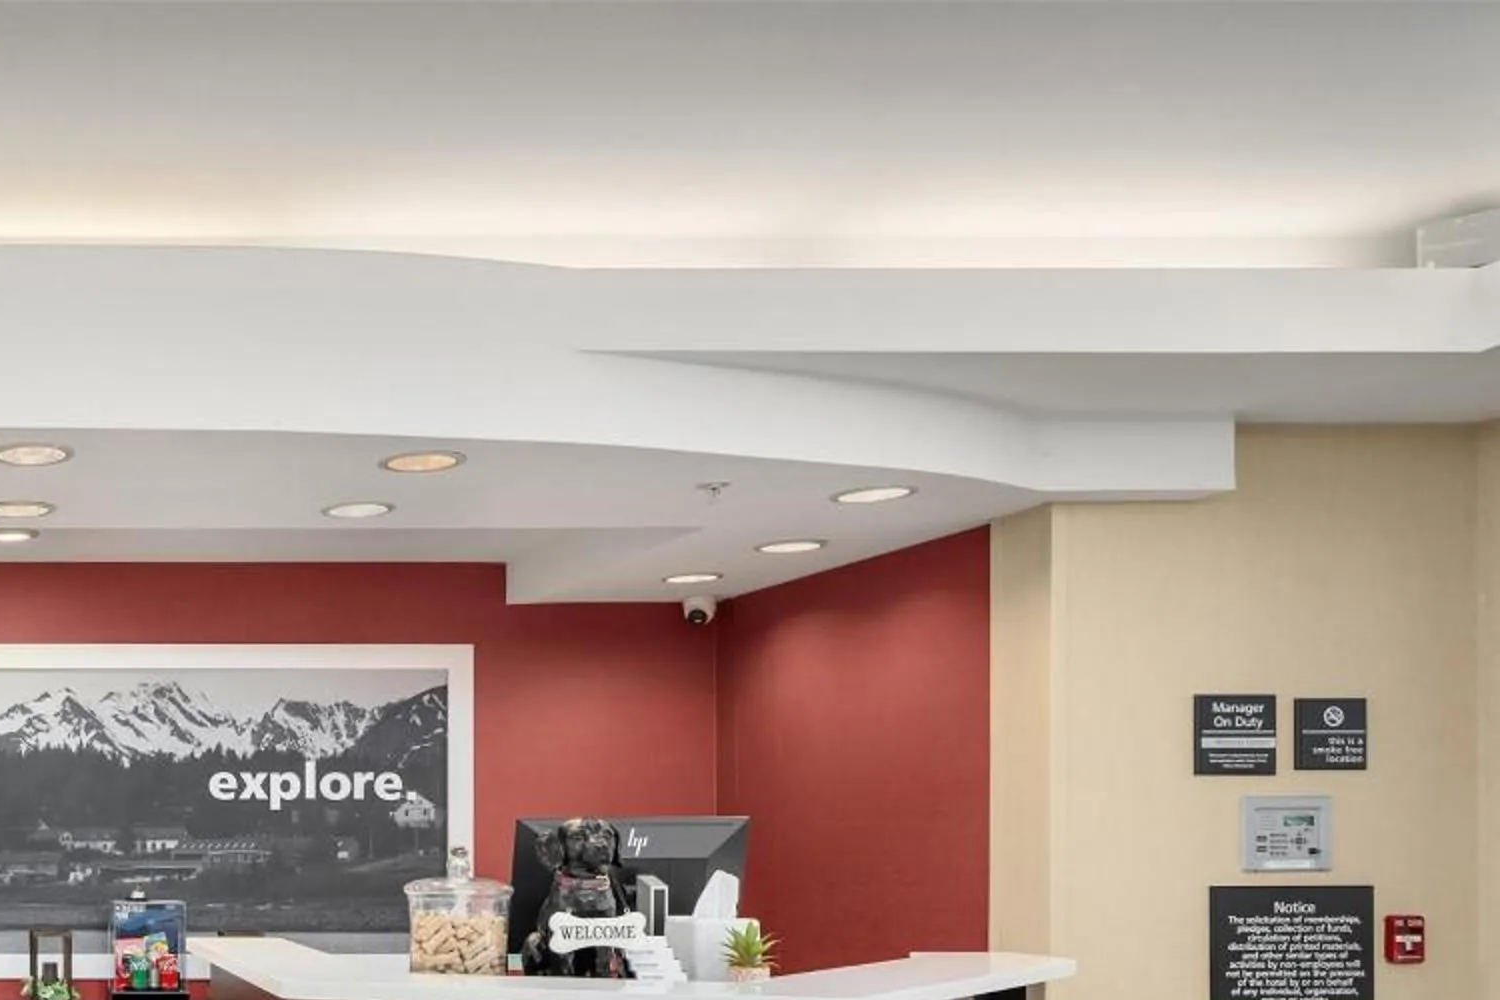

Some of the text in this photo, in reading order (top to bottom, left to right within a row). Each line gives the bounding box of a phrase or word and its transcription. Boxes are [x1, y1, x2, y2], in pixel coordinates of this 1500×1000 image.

[1212, 702, 1264, 716] Manager
[1213, 715, 1263, 730] On Duty
[1328, 736, 1345, 745] this
[1347, 736, 1355, 745] is
[1312, 745, 1364, 755] smoke free
[1326, 754, 1364, 763] location
[208, 760, 417, 811] explore.
[1273, 901, 1316, 914] Notice
[1228, 915, 1244, 924] The
[1246, 915, 1290, 924] solicitation
[1293, 915, 1302, 924] of
[559, 925, 637, 940] WELCOME
[1273, 924, 1313, 934] collection
[1316, 924, 1324, 934] of
[1292, 934, 1302, 942] of
[1228, 943, 1276, 951] distribution
[1278, 943, 1288, 951] of
[1290, 943, 1320, 951] printed
[1242, 952, 1348, 960] and other similar types of
[1229, 960, 1361, 969] activities by non-employees will
[1237, 978, 1353, 987] of the hotel by or on behalf
[1231, 987, 1241, 996] of
[1243, 987, 1258, 996] any
